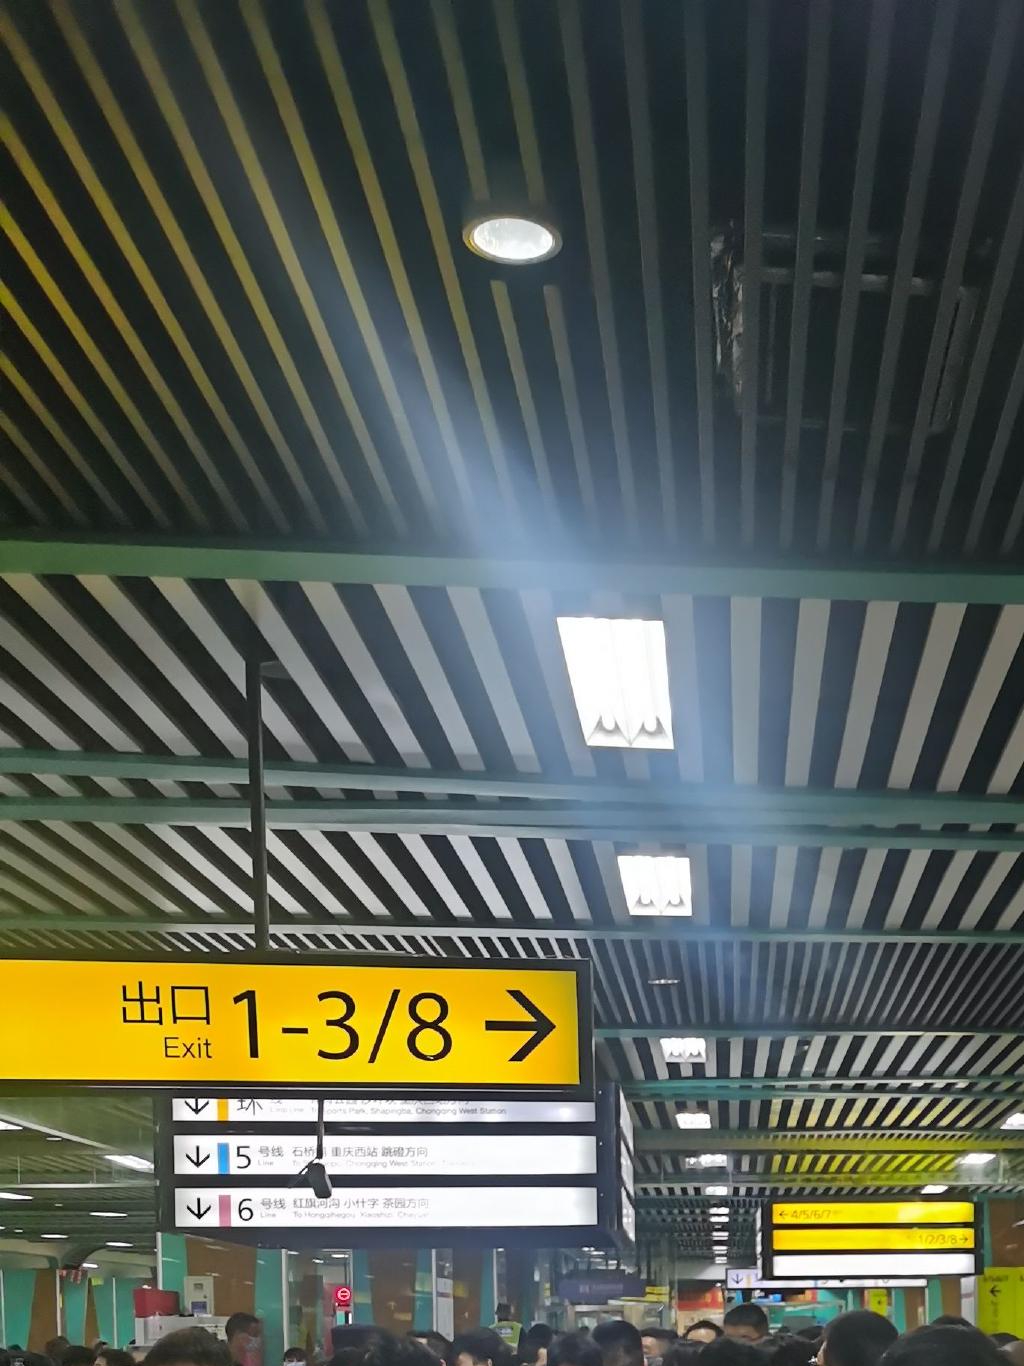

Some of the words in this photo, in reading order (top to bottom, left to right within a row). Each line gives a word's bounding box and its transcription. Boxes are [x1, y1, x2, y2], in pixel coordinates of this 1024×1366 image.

[122, 981, 212, 1026] 出口
[233, 989, 453, 1064] 1-3/8
[163, 1037, 213, 1059] Exit
[236, 1146, 251, 1169] 5
[258, 1145, 284, 1157] 号线
[331, 1145, 378, 1157] 重庆西站
[238, 1198, 254, 1221] 6
[260, 1198, 286, 1210] 号线
[293, 1197, 341, 1209] 红旗河沟
[344, 1197, 380, 1209] 小什字
[382, 1197, 429, 1209] 茶园方向
[791, 1209, 831, 1220] 4/5/6/7
[918, 1234, 958, 1245] 1/2/3/8
